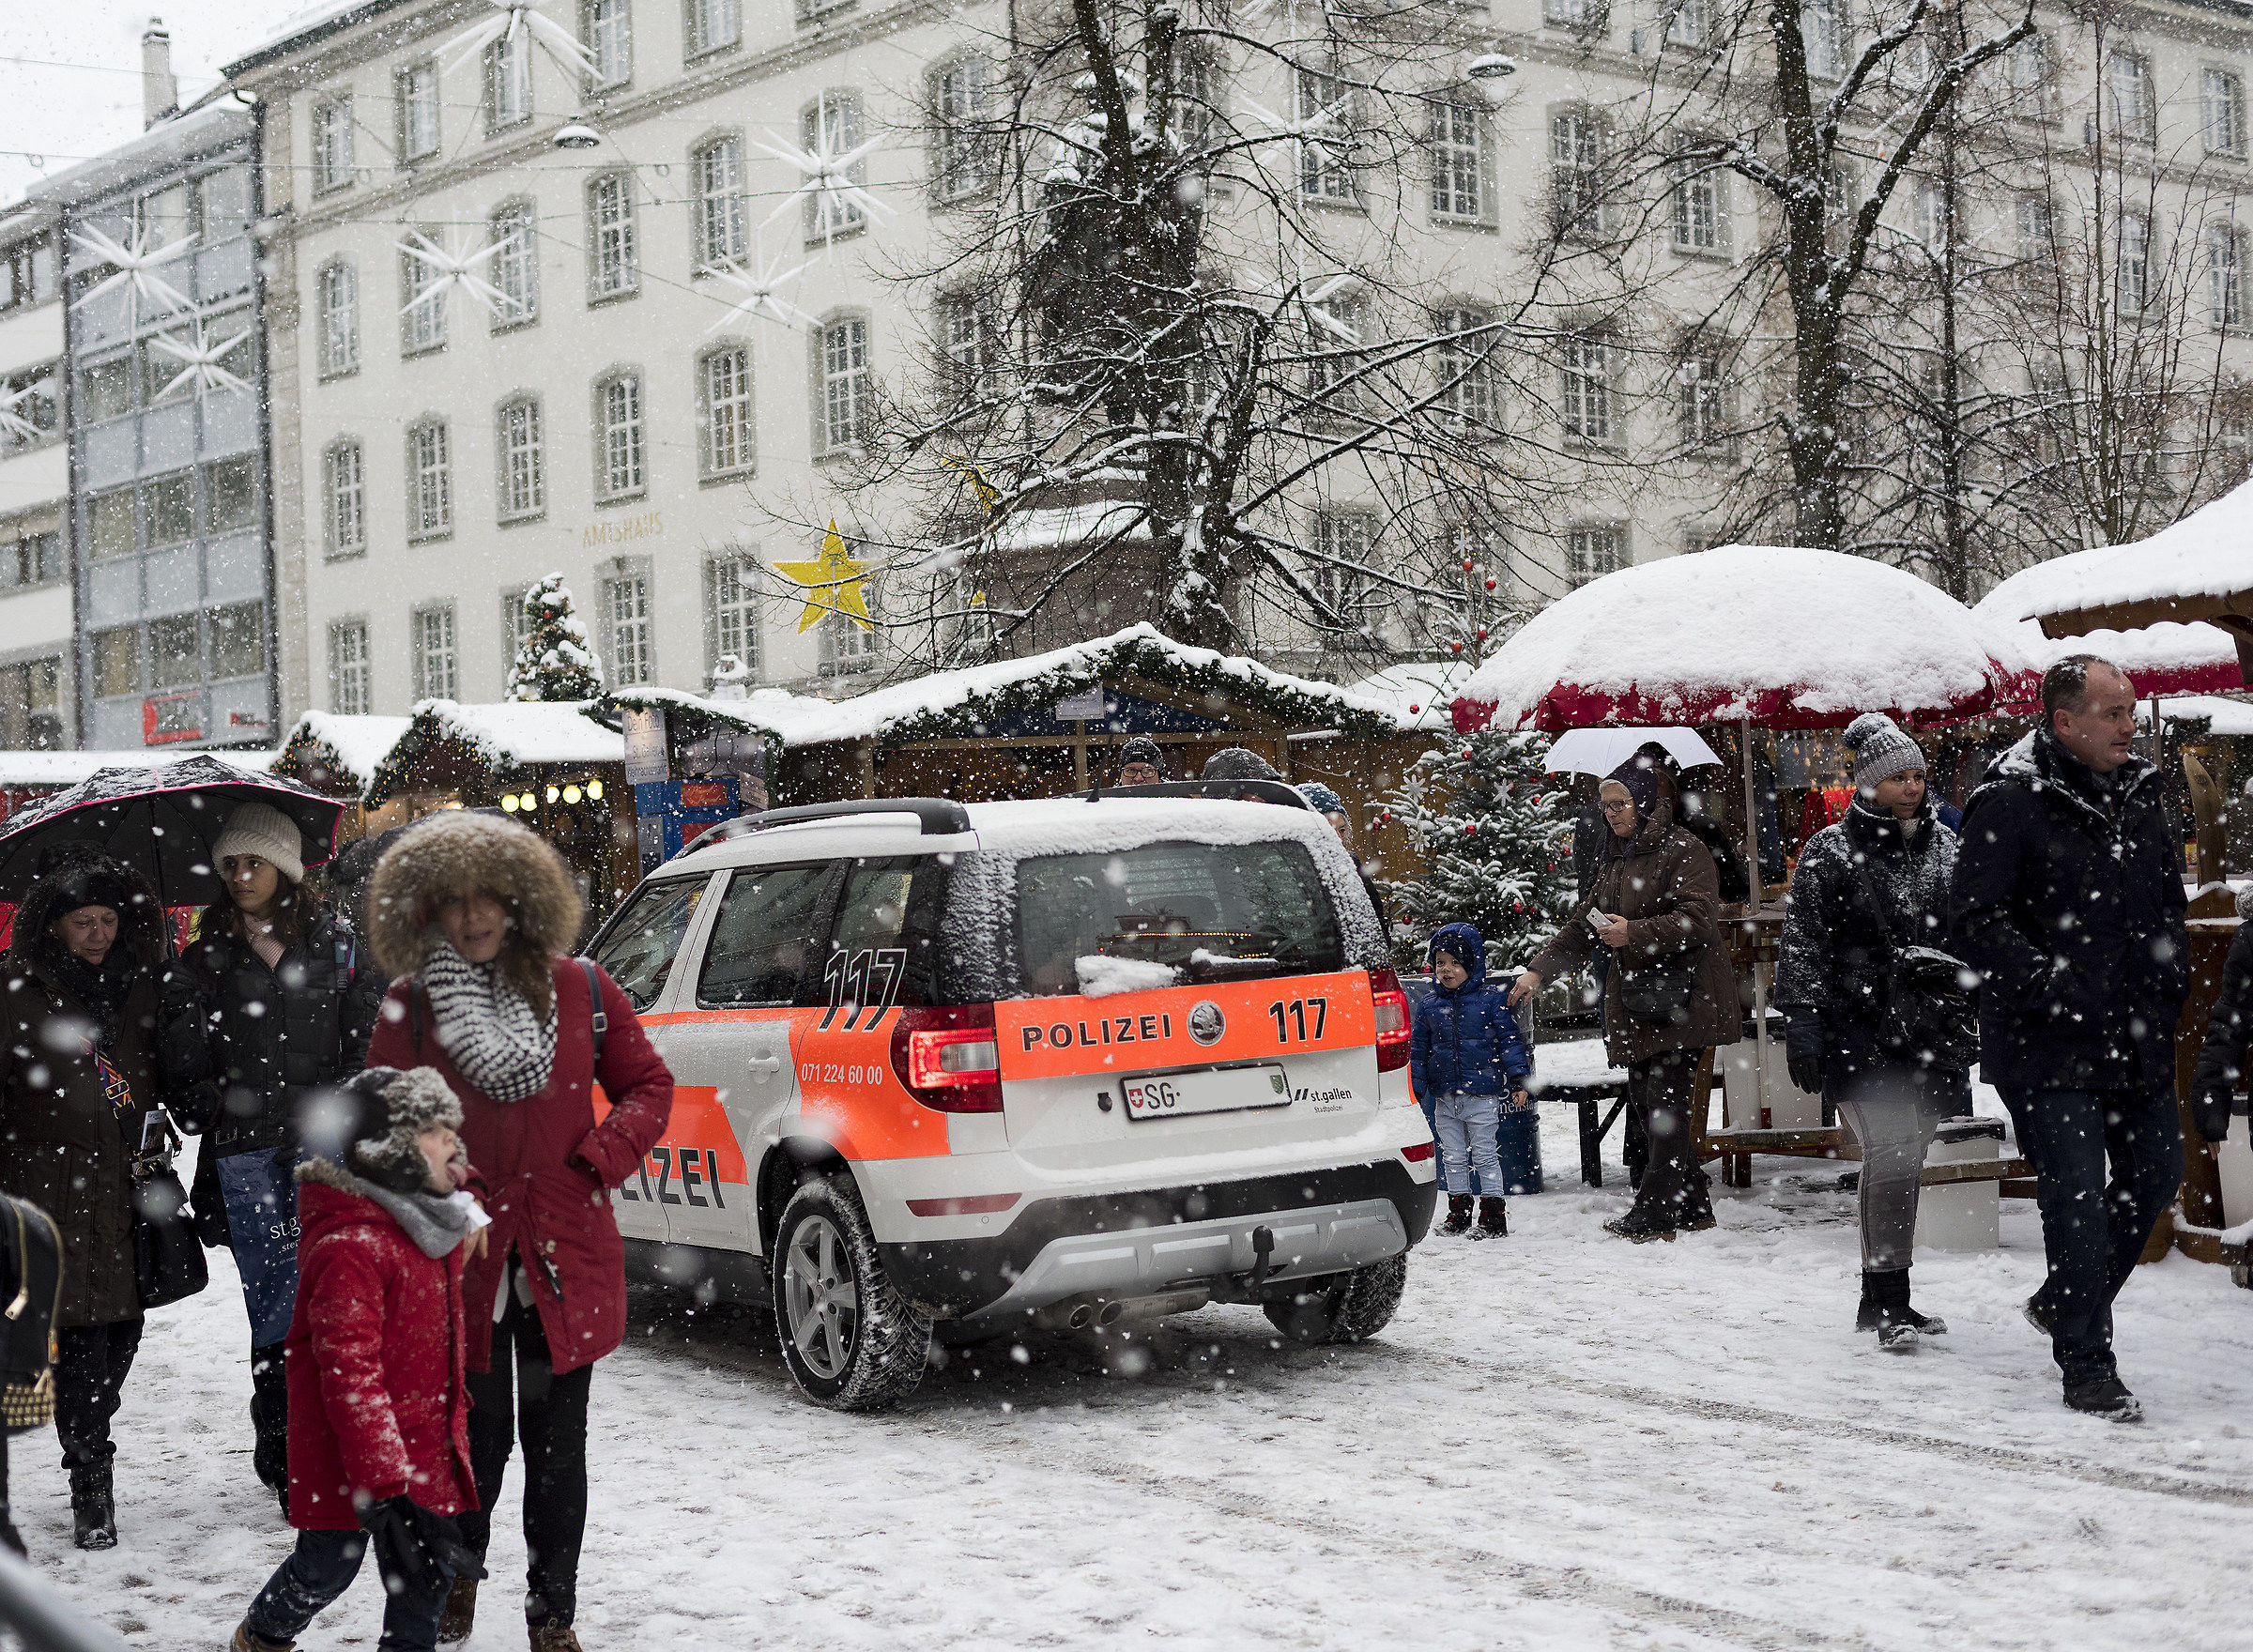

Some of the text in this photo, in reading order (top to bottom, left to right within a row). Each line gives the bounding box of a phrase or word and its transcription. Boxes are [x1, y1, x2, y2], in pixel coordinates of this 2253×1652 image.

[583, 512, 664, 548] AMTSHAUS
[817, 949, 907, 1032] 117
[1020, 1012, 1172, 1053] POLIZEI
[1269, 996, 1328, 1044] 117
[802, 1063, 883, 1085] 071 224 60 00
[1310, 1088, 1353, 1103] st.gallen
[620, 1145, 726, 1210] LIZEI
[269, 1215, 302, 1239] st.g
